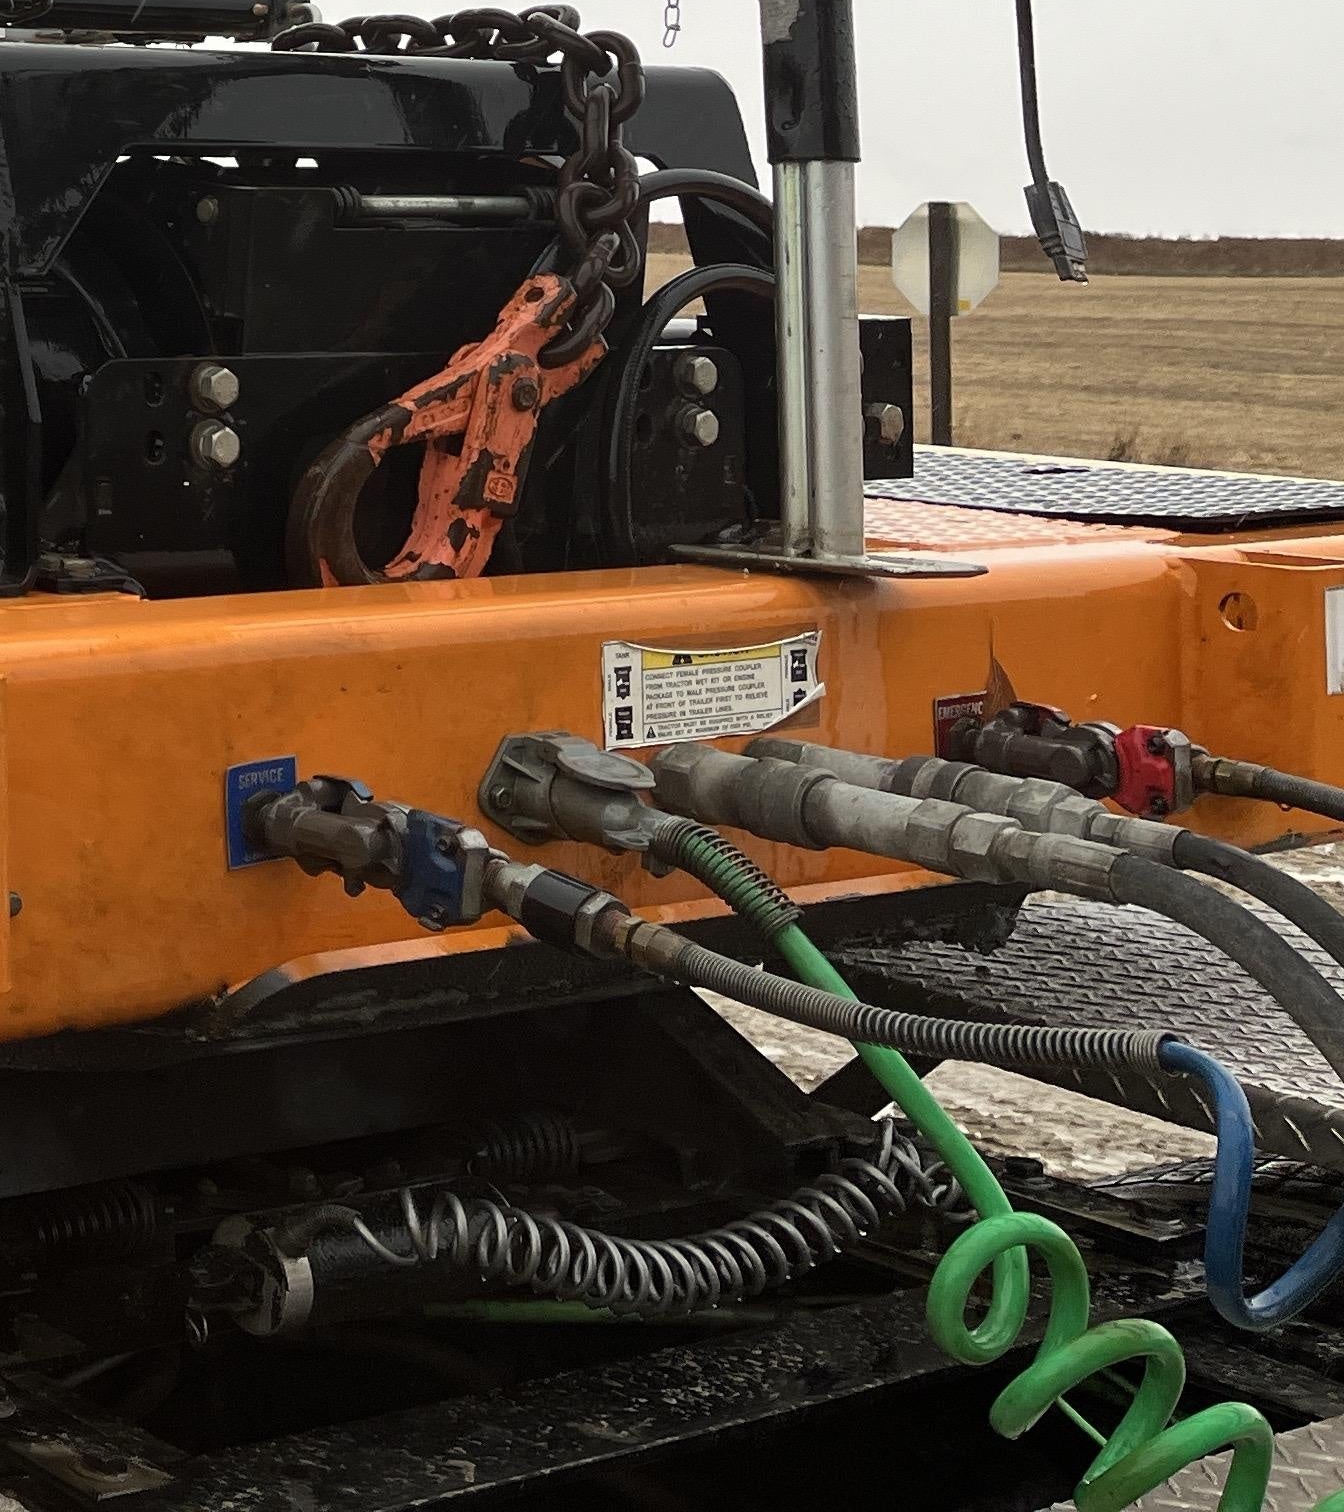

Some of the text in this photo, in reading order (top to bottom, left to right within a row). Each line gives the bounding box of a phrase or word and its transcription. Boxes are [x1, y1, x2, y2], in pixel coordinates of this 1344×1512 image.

[734, 663, 762, 671] COUPLER
[738, 682, 765, 691] COUPLER
[938, 700, 984, 720] EMERGENC
[238, 767, 284, 790] SERVICE
